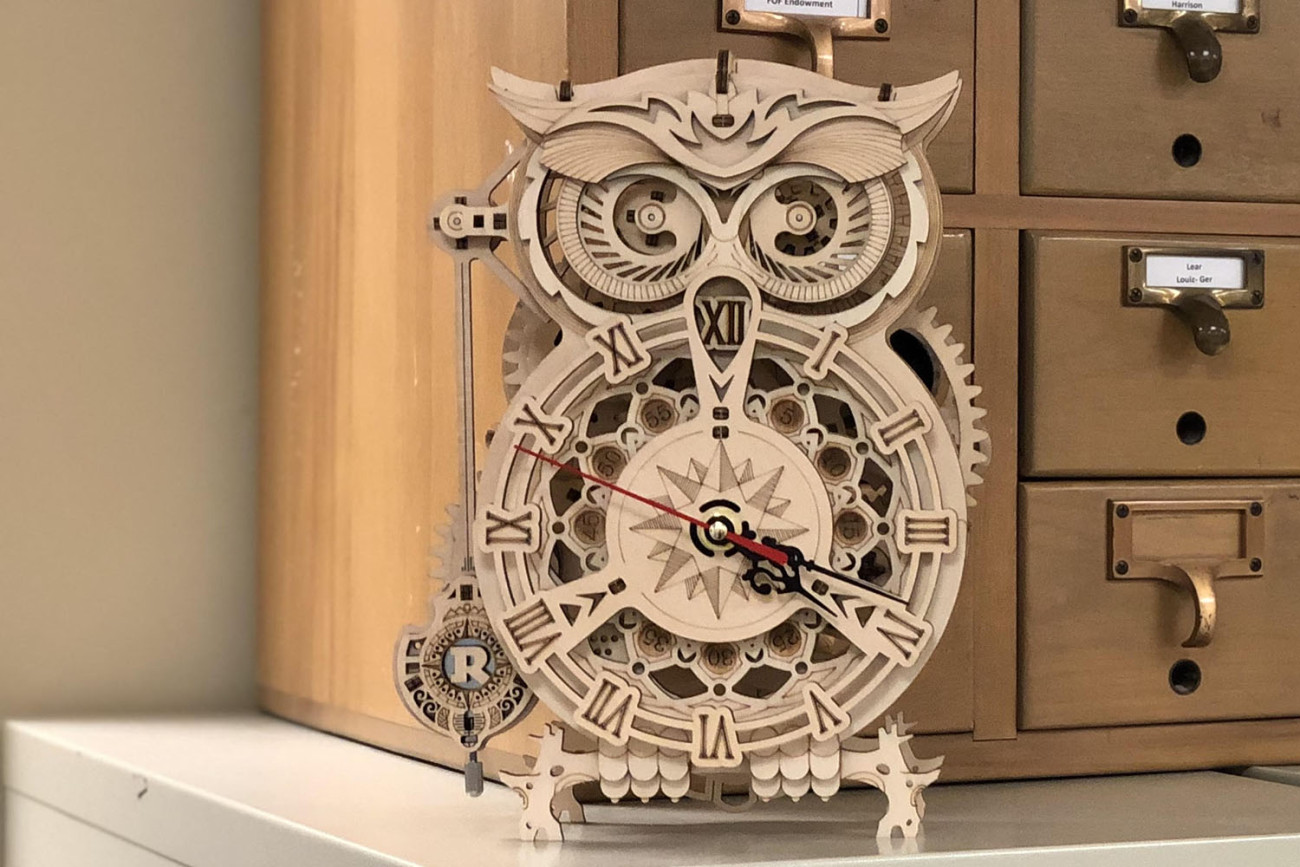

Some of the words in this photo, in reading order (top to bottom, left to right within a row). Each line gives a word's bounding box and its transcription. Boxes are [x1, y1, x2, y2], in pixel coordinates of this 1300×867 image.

[784, 0, 833, 8] Endowment
[1171, 1, 1203, 9] Harrison
[1186, 263, 1202, 271] Lear
[701, 299, 747, 345] XII
[593, 321, 643, 376] XI
[513, 402, 566, 447] X
[486, 510, 533, 546] IX
[904, 515, 950, 547] III
[449, 645, 491, 684] R
[698, 713, 735, 760] VI
